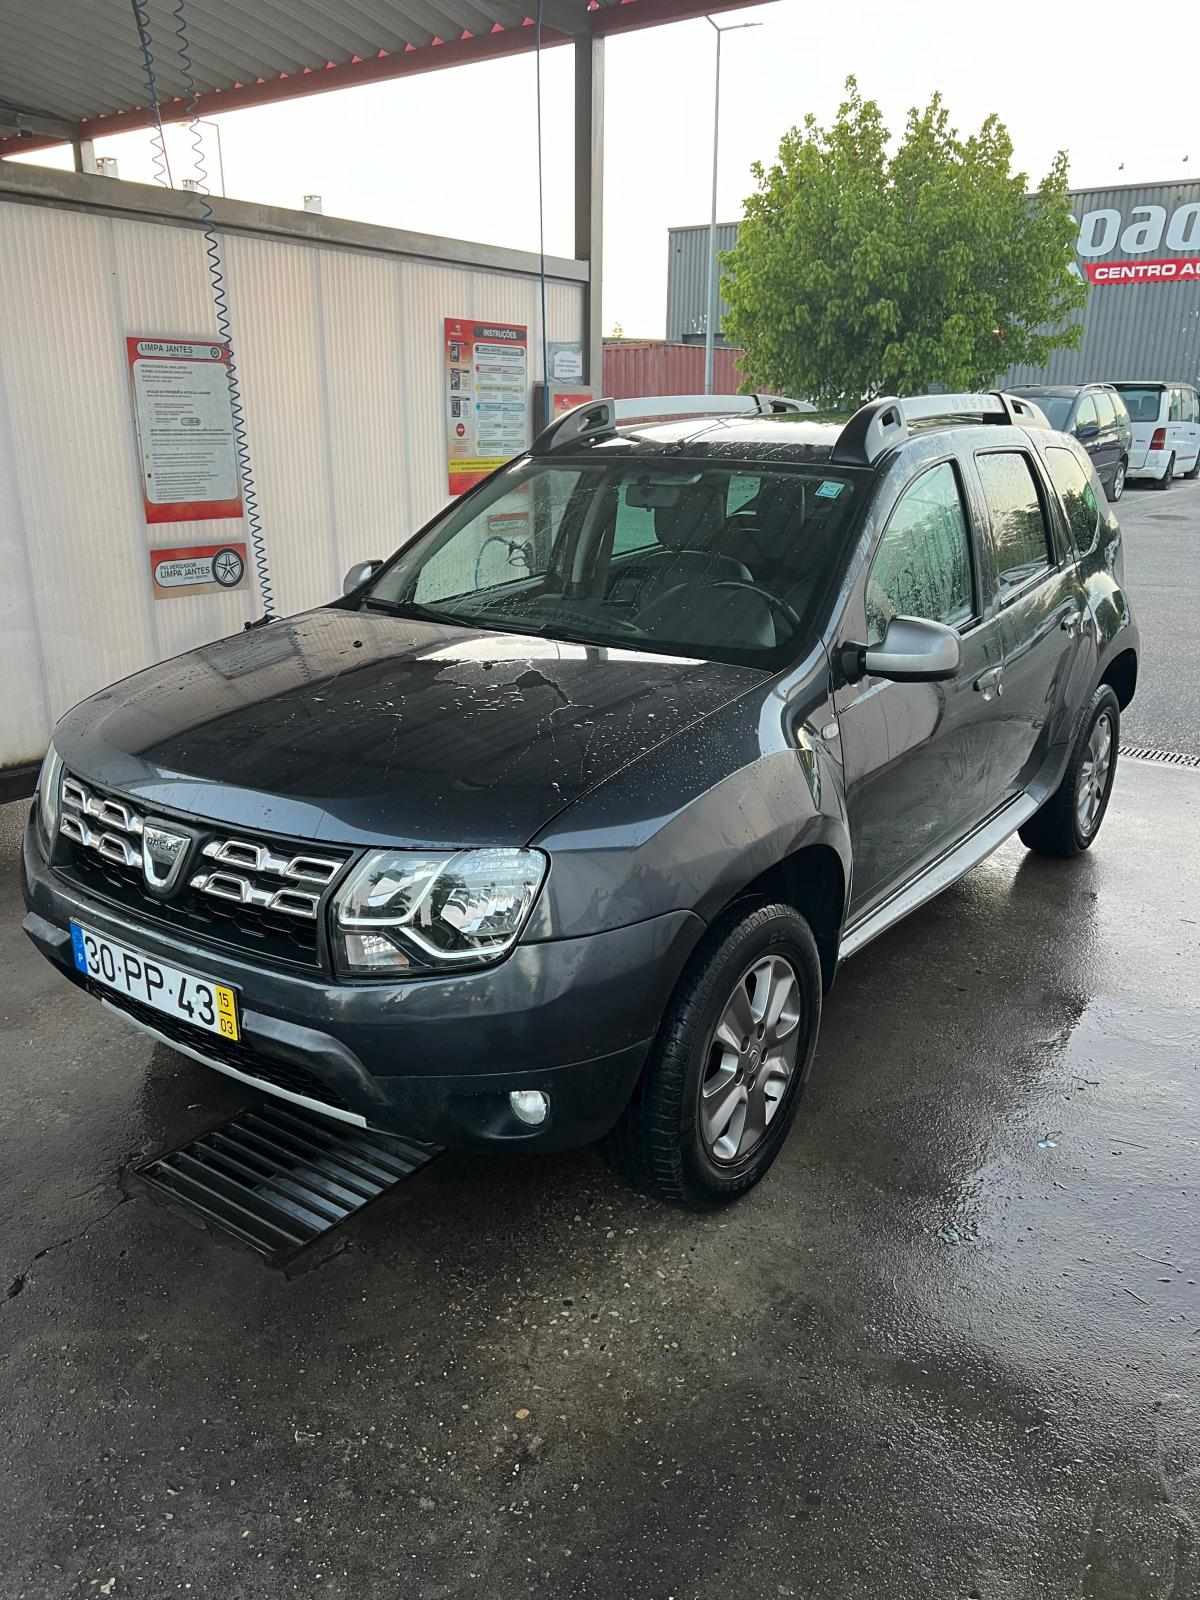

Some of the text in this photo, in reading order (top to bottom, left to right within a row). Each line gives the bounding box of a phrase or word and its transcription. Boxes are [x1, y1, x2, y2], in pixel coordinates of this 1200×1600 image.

[1066, 202, 1200, 278] oad
[1095, 263, 1176, 279] CENTRO
[483, 328, 517, 339] INSTRUÇÕES
[141, 343, 192, 354] LIMPA JANTES
[160, 567, 182, 578] LIMPA
[184, 566, 210, 577] JANTES
[219, 991, 229, 1008] 15
[220, 1018, 233, 1035] 03
